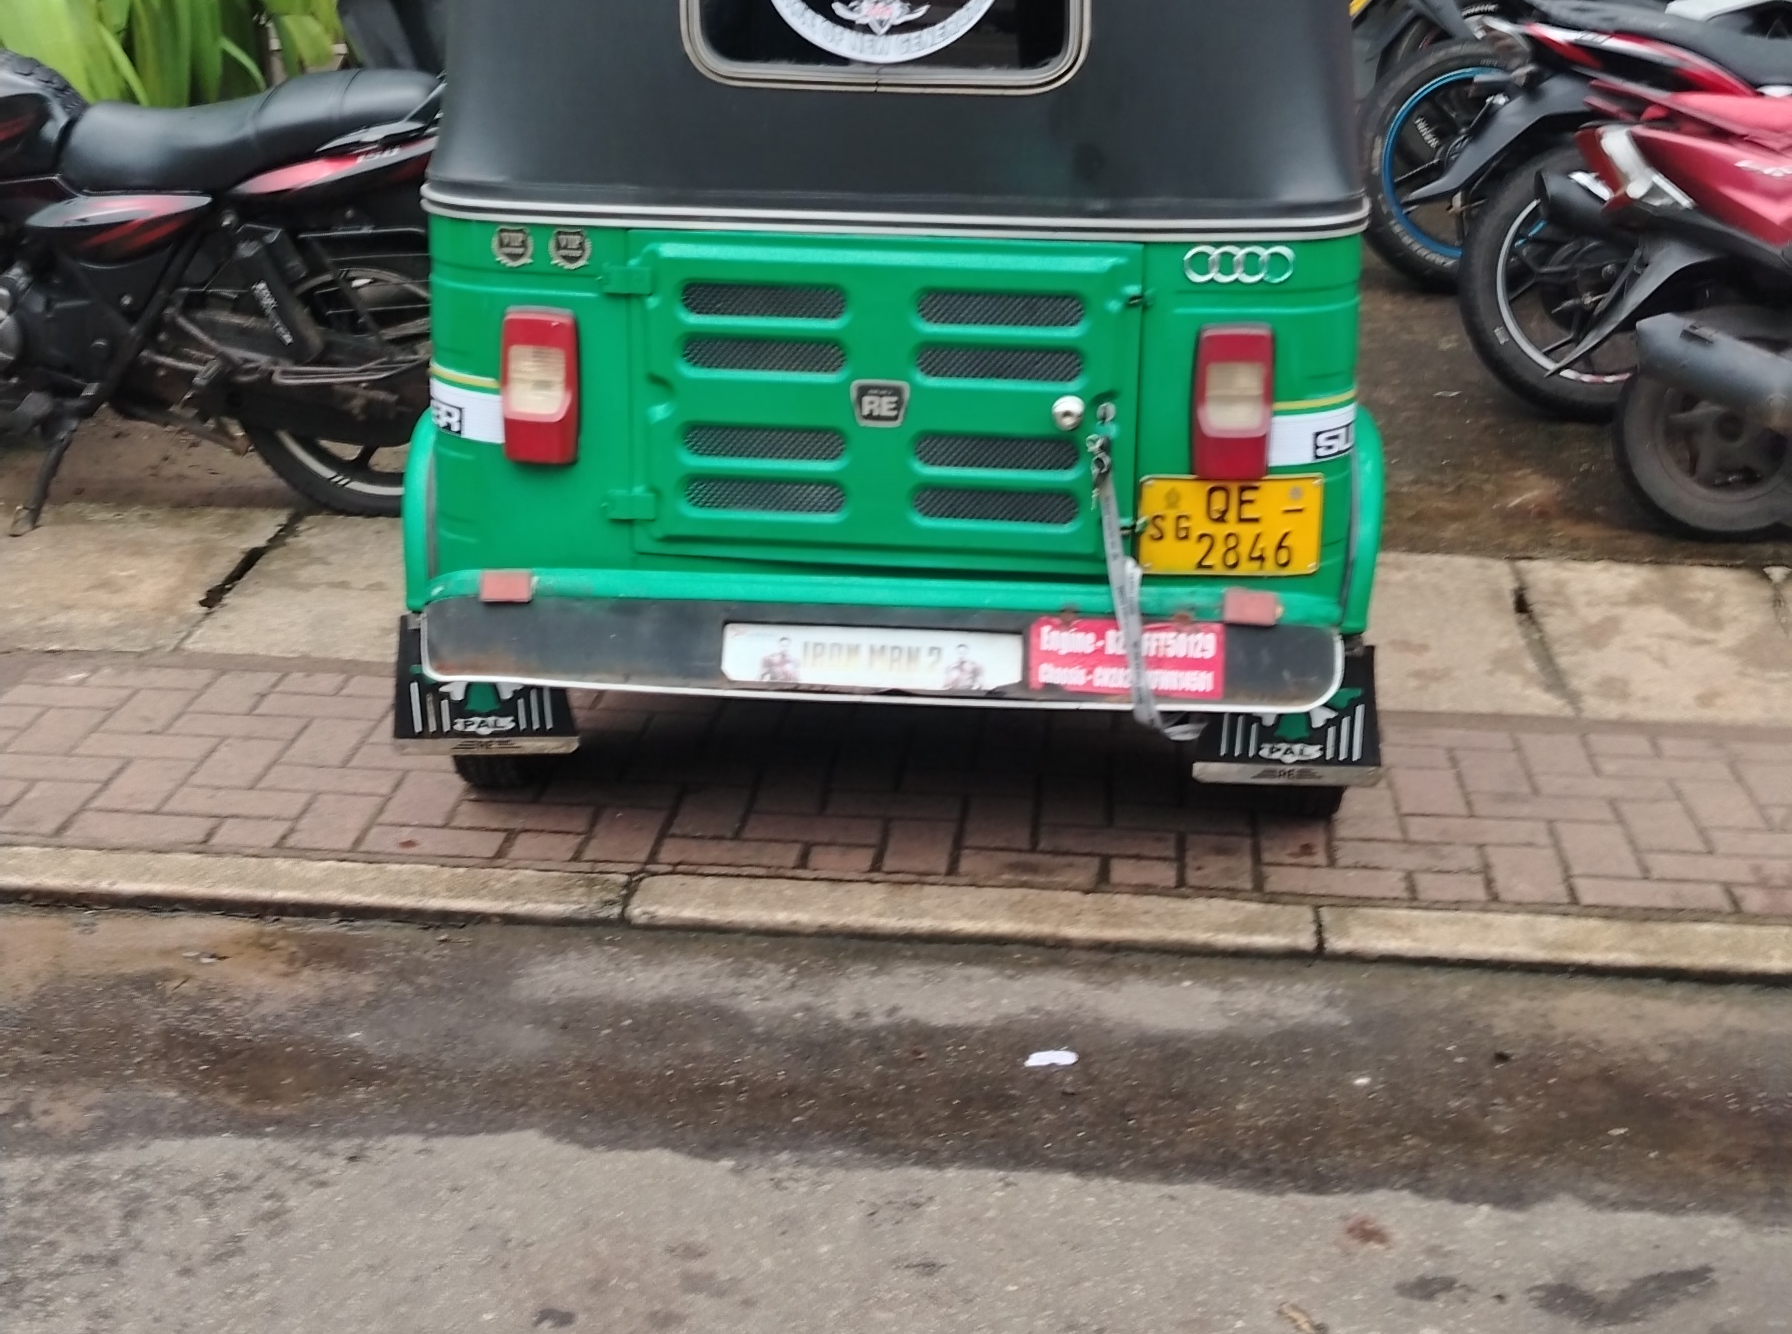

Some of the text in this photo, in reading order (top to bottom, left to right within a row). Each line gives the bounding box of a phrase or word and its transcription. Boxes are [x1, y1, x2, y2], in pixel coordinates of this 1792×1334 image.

[861, 395, 899, 417] RE
[1206, 485, 1261, 524] QE
[1149, 513, 1191, 541] SG
[1195, 530, 1293, 570] 2846
